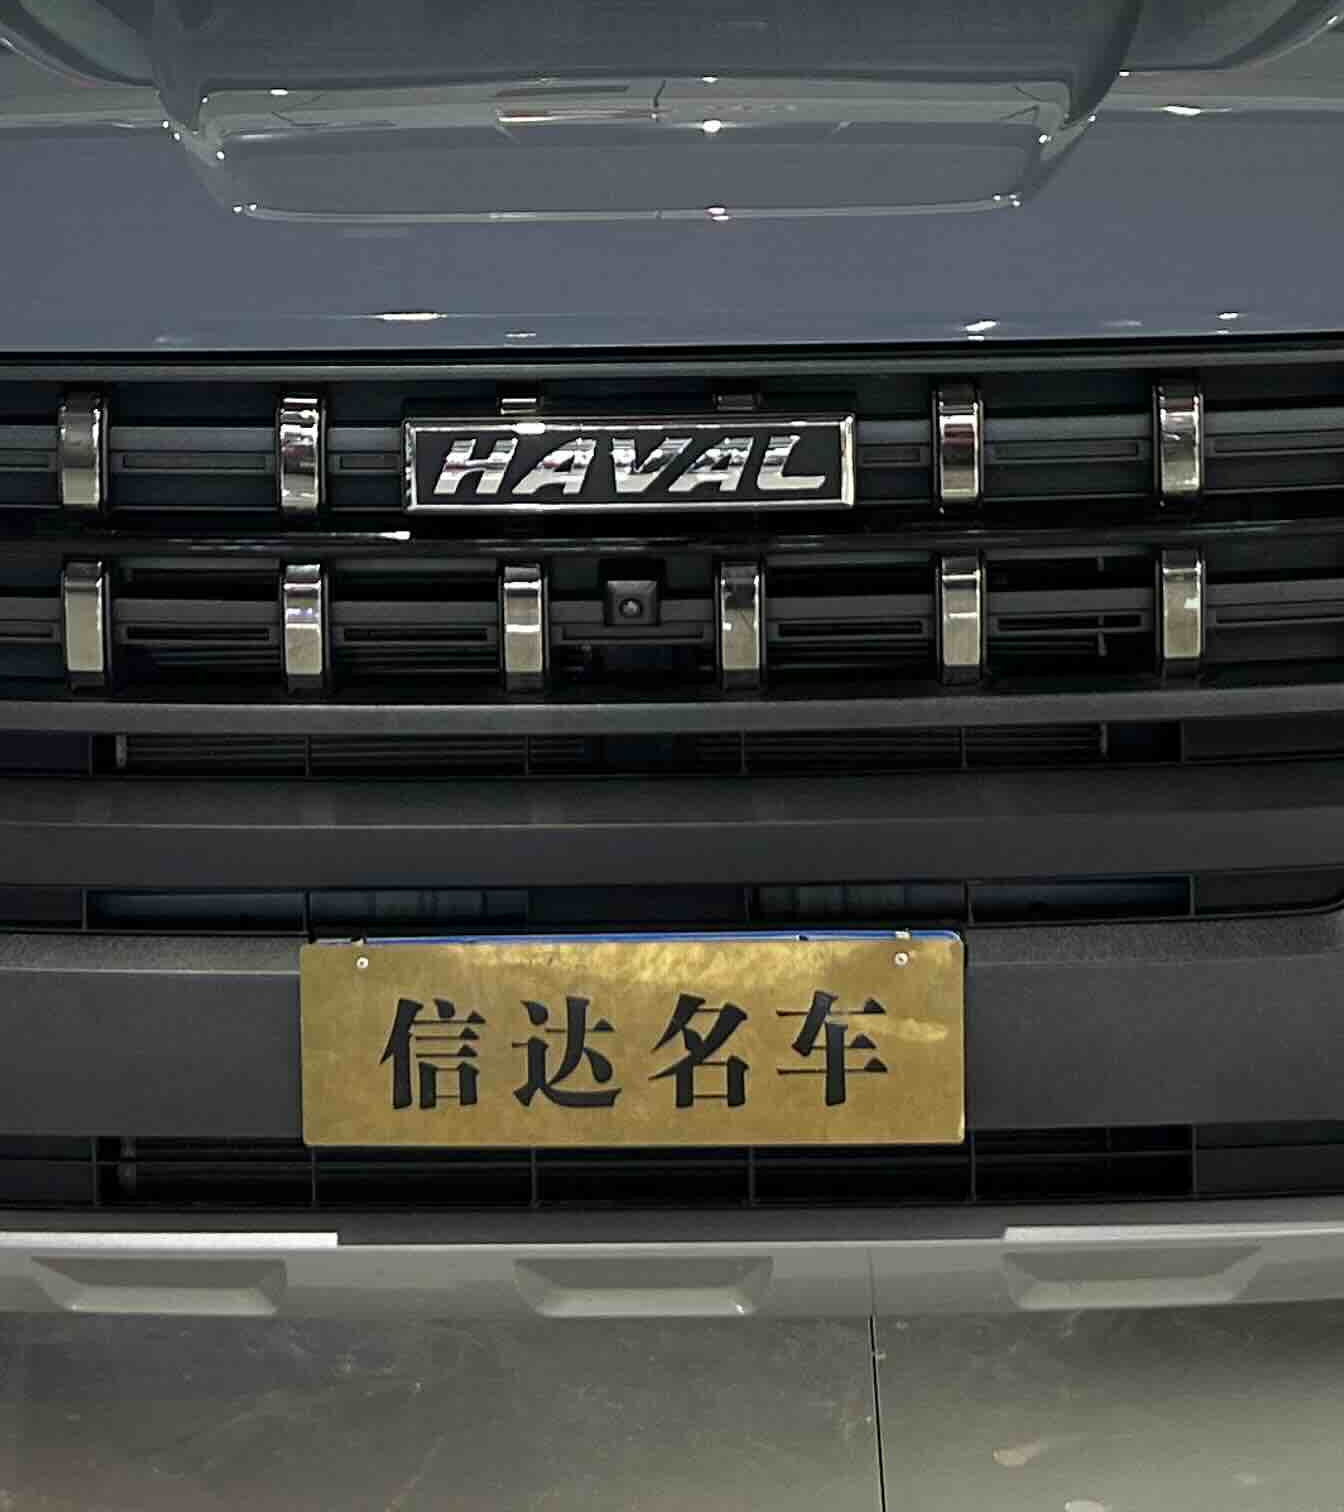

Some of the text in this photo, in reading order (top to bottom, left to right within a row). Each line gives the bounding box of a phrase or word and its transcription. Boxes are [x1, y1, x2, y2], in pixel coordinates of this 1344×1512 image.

[433, 434, 827, 495] HAVAL
[379, 990, 888, 1111] 信达名车
